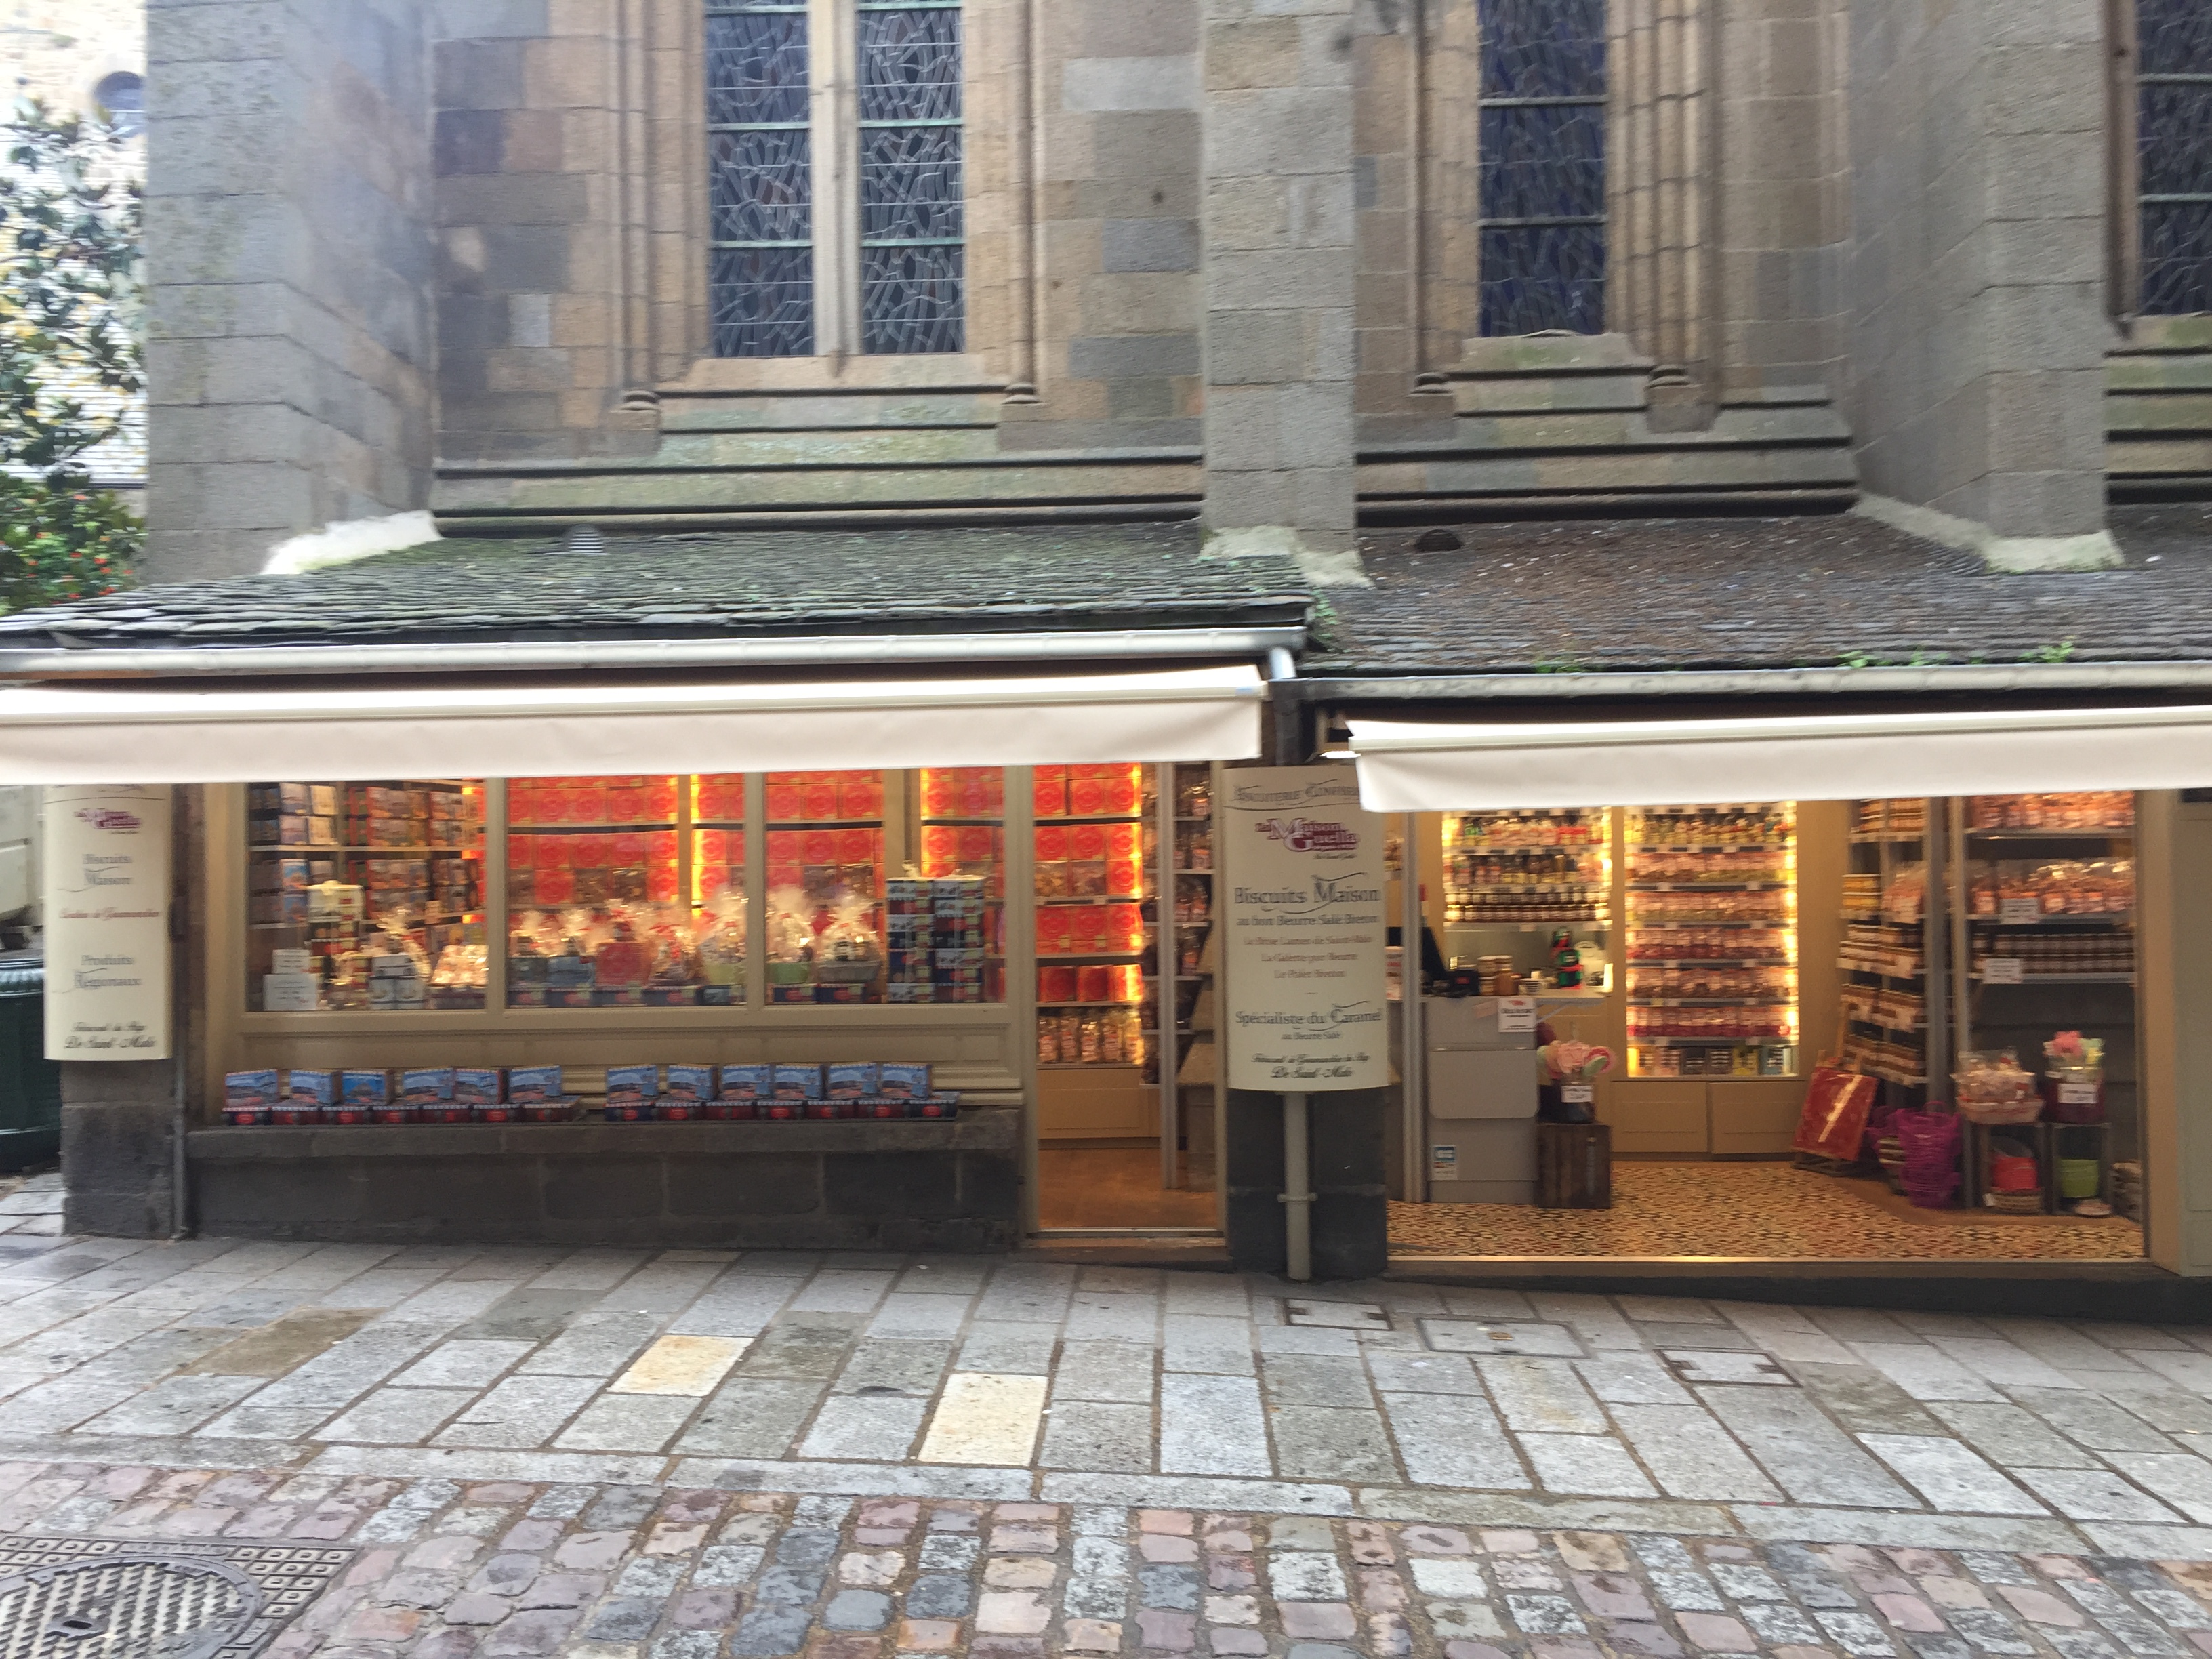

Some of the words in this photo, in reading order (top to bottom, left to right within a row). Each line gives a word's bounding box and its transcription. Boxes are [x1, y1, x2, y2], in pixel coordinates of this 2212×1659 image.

[1233, 886, 1307, 904] Biscuits
[1312, 881, 1381, 903] Maison
[1235, 1010, 1305, 1027] Spécialiste
[1306, 1011, 1327, 1024] du
